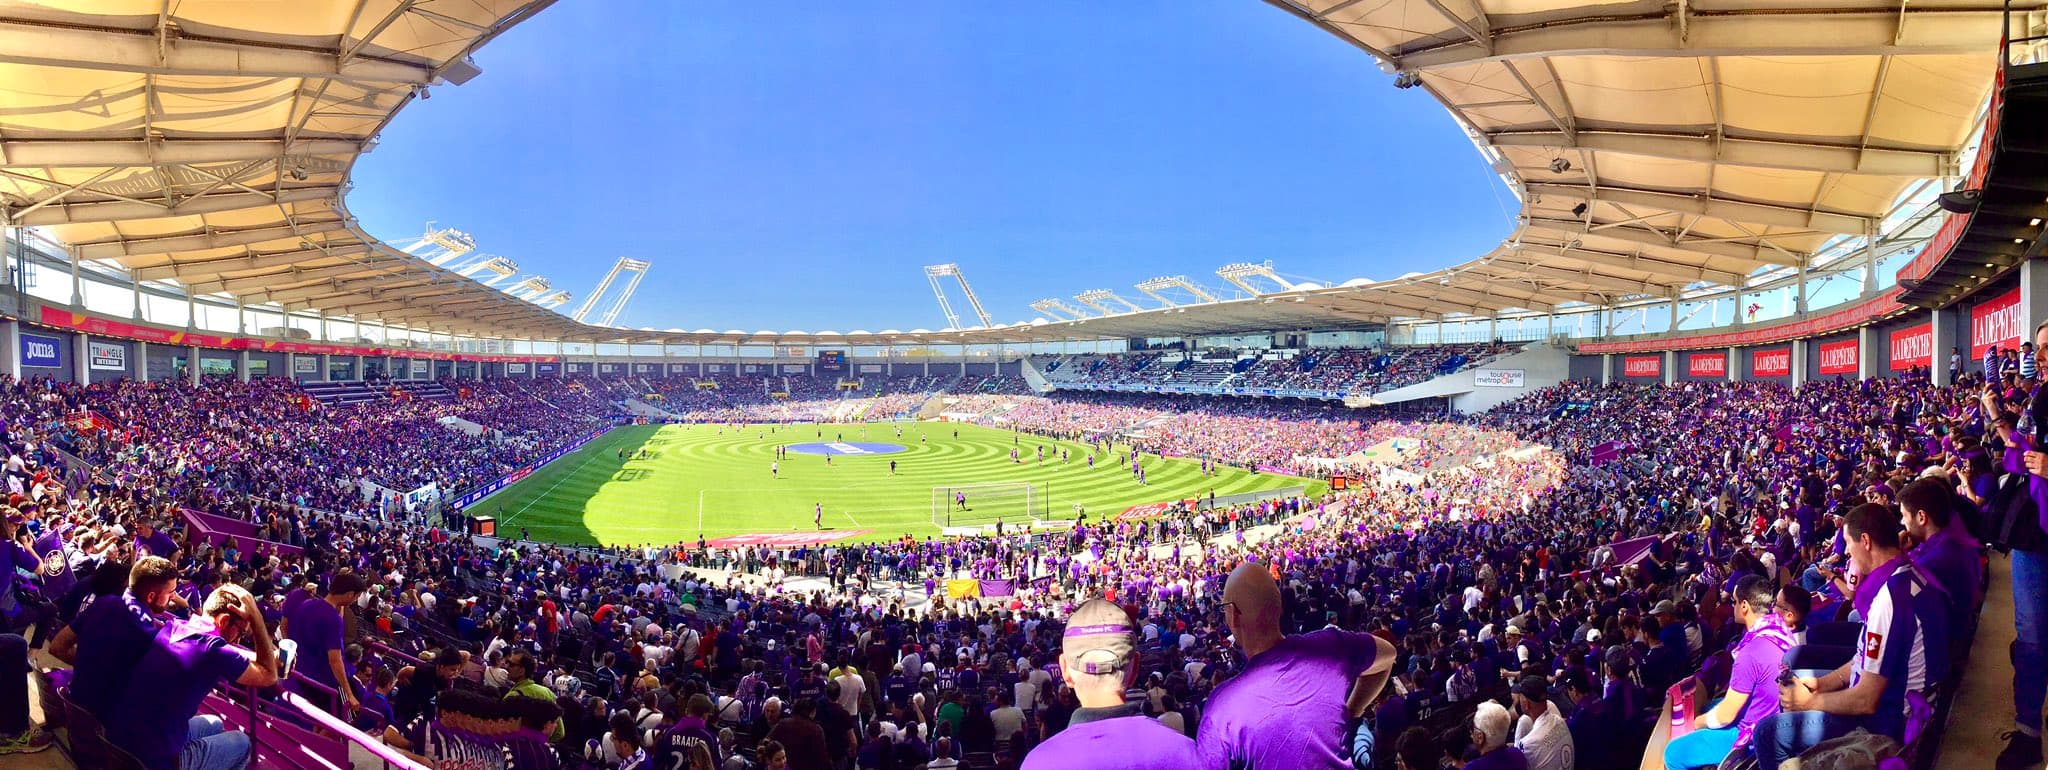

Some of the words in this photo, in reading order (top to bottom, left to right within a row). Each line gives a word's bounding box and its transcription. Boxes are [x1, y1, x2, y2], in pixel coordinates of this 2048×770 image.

[1974, 316, 1985, 347] LA
[92, 346, 122, 358] TRIANGLE
[1891, 340, 1901, 361] LA
[1691, 359, 1699, 371] LA
[1755, 356, 1763, 370] LA
[1821, 350, 1830, 367] LA
[671, 734, 700, 748] BRAATE
